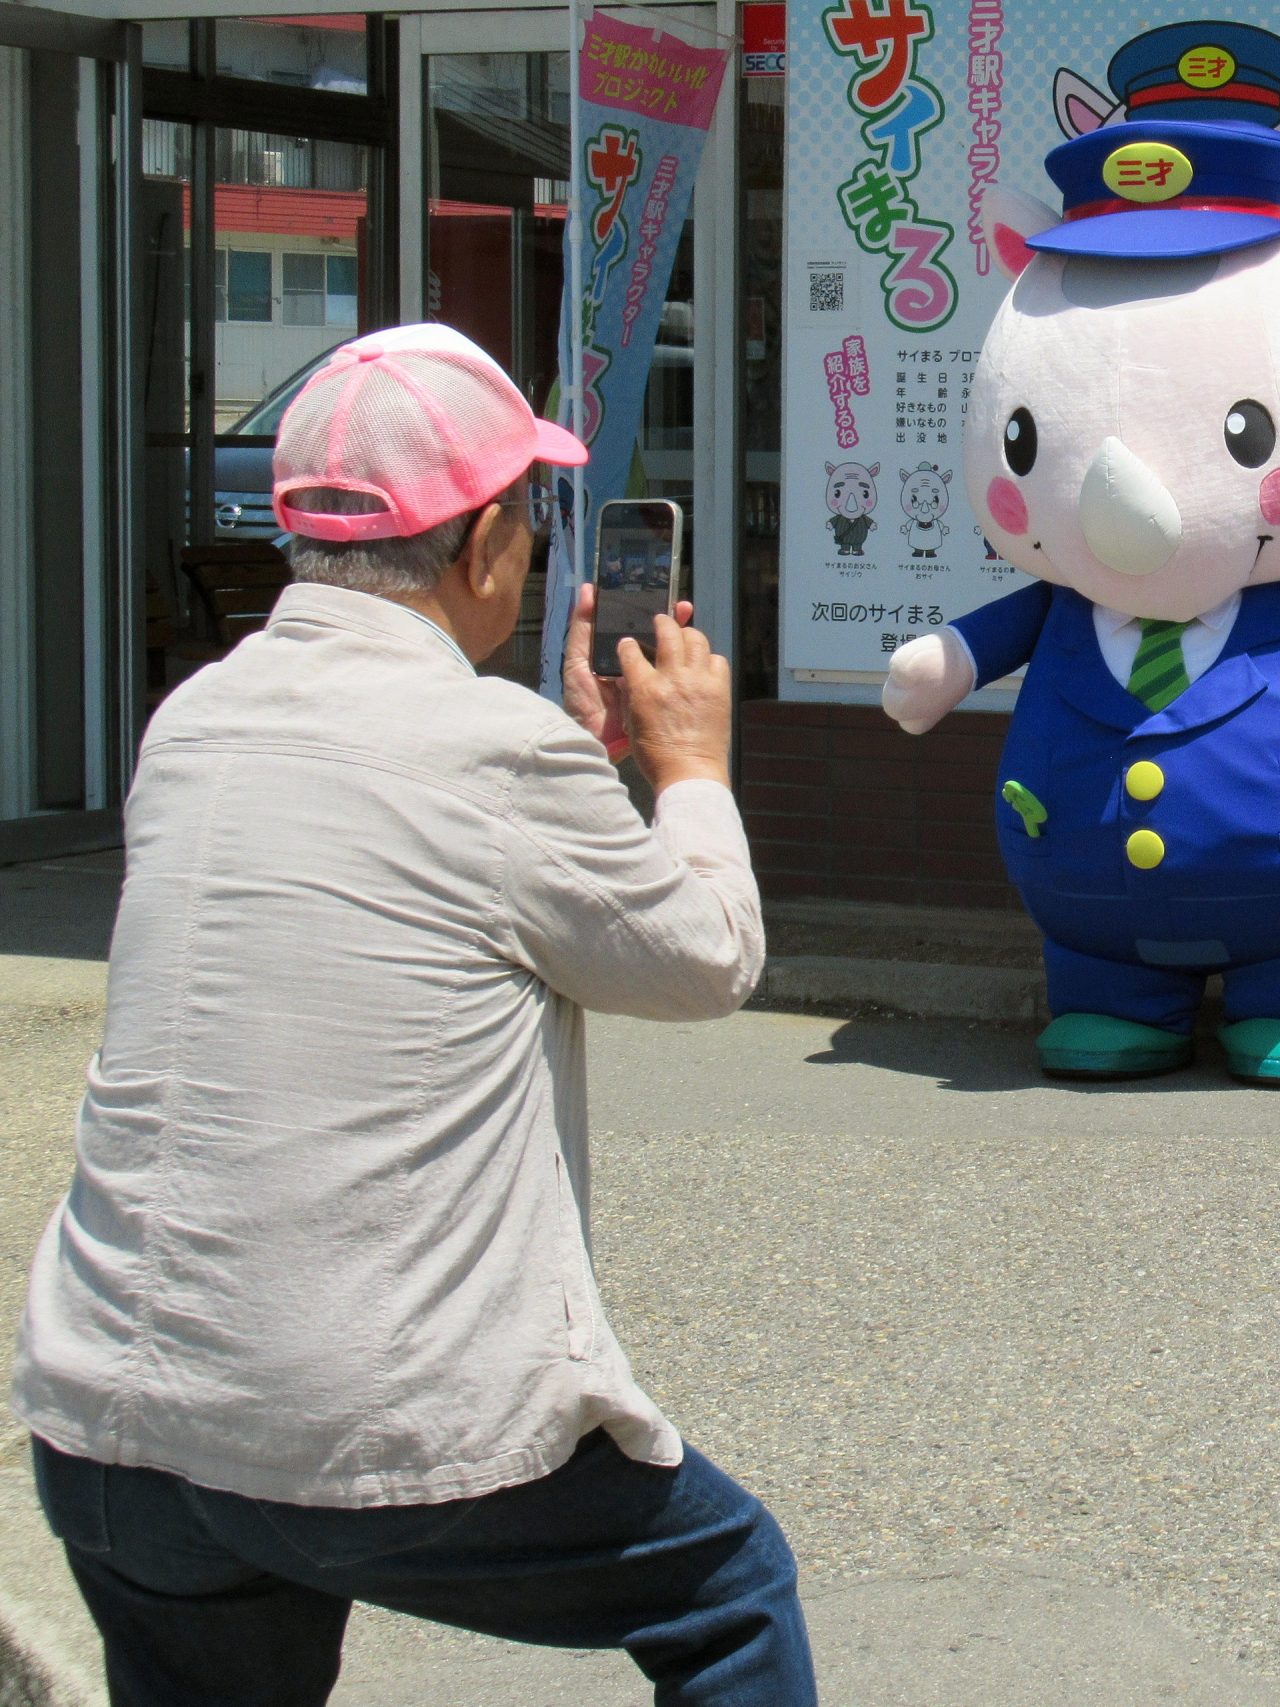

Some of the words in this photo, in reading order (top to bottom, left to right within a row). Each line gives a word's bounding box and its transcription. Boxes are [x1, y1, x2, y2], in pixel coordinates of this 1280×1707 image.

[1187, 57, 1227, 78] 三才
[593, 72, 679, 113] プロジェクト
[824, 0, 957, 332] サイまる
[1117, 158, 1174, 186] 三才
[620, 156, 680, 347] 三才駅キャラクター
[844, 337, 870, 394] 家族を
[897, 350, 942, 363] サイまる
[896, 372, 947, 384] 誕生日
[825, 353, 858, 447] 紹介するね
[896, 402, 947, 413] 好きなもの
[896, 417, 947, 428] 嫌いなもの
[896, 432, 948, 443] 出没地
[811, 602, 944, 625] 次回のサイまる
